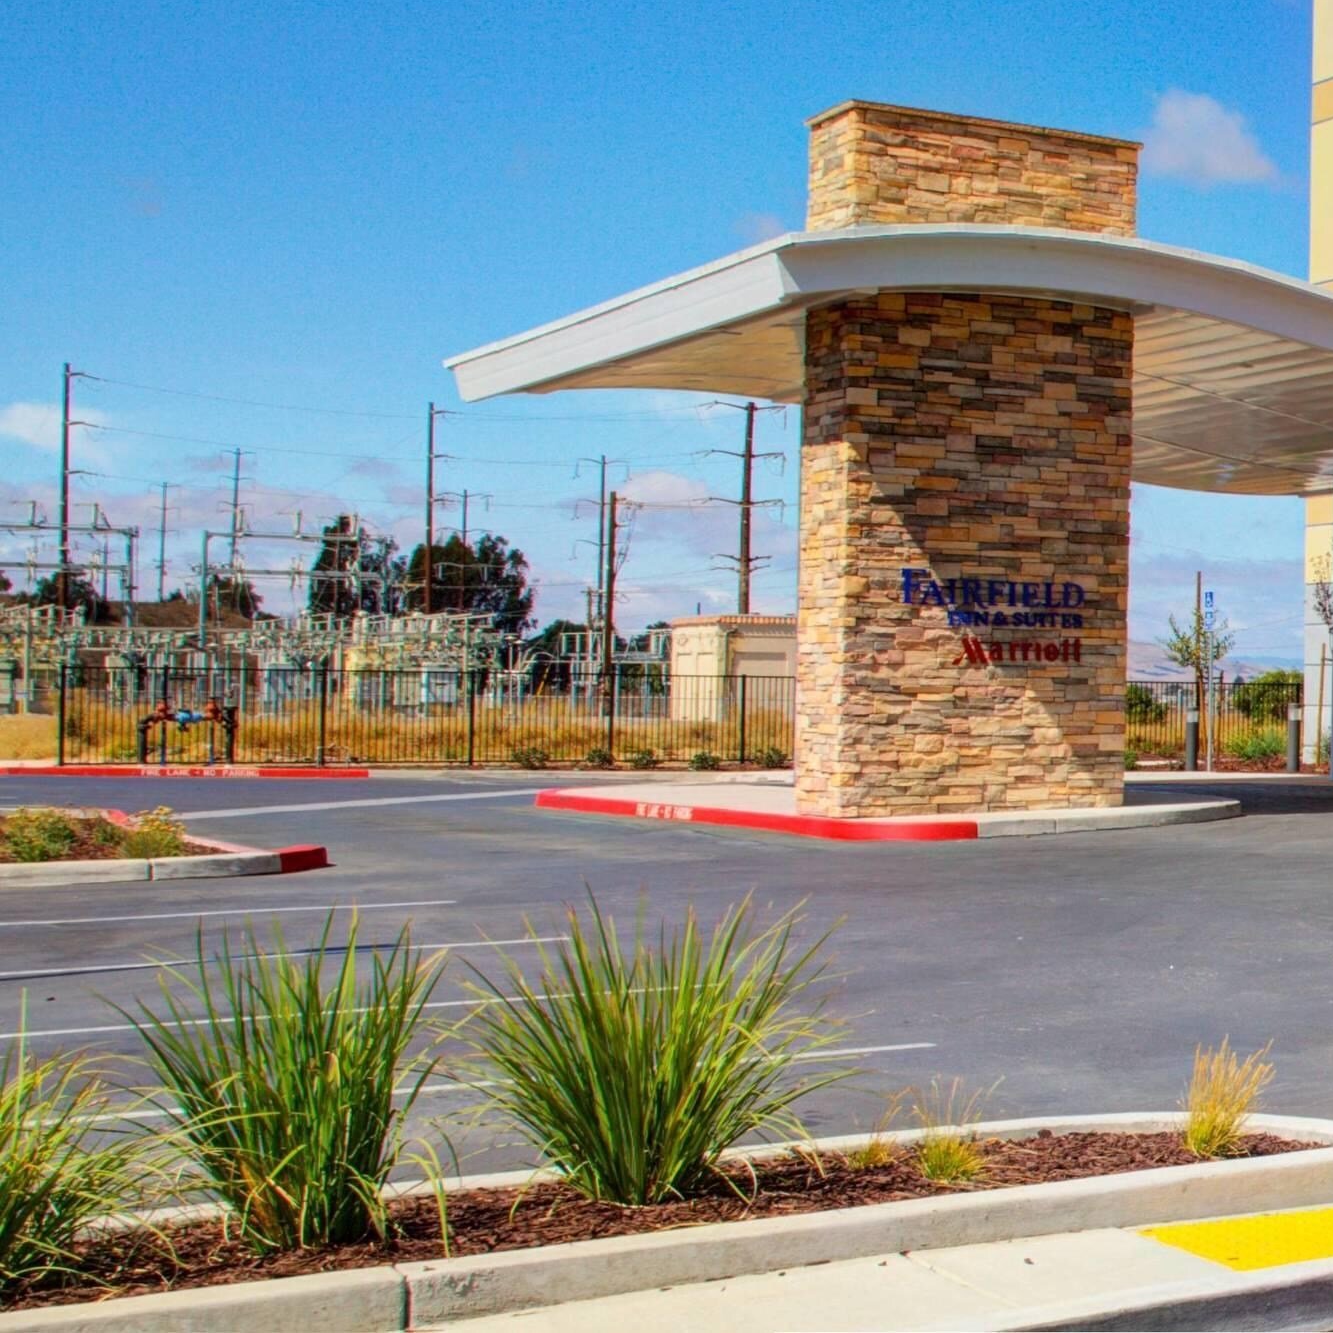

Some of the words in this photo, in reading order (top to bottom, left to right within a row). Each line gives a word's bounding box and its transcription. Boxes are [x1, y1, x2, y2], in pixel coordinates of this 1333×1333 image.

[902, 568, 1085, 608] FAIRFIELD
[948, 610, 990, 627] INN
[992, 611, 1009, 626] &
[1012, 612, 1083, 629] SUITES
[952, 636, 1082, 665] Marriott
[203, 768, 216, 777] NO
[222, 768, 260, 777] PARKING
